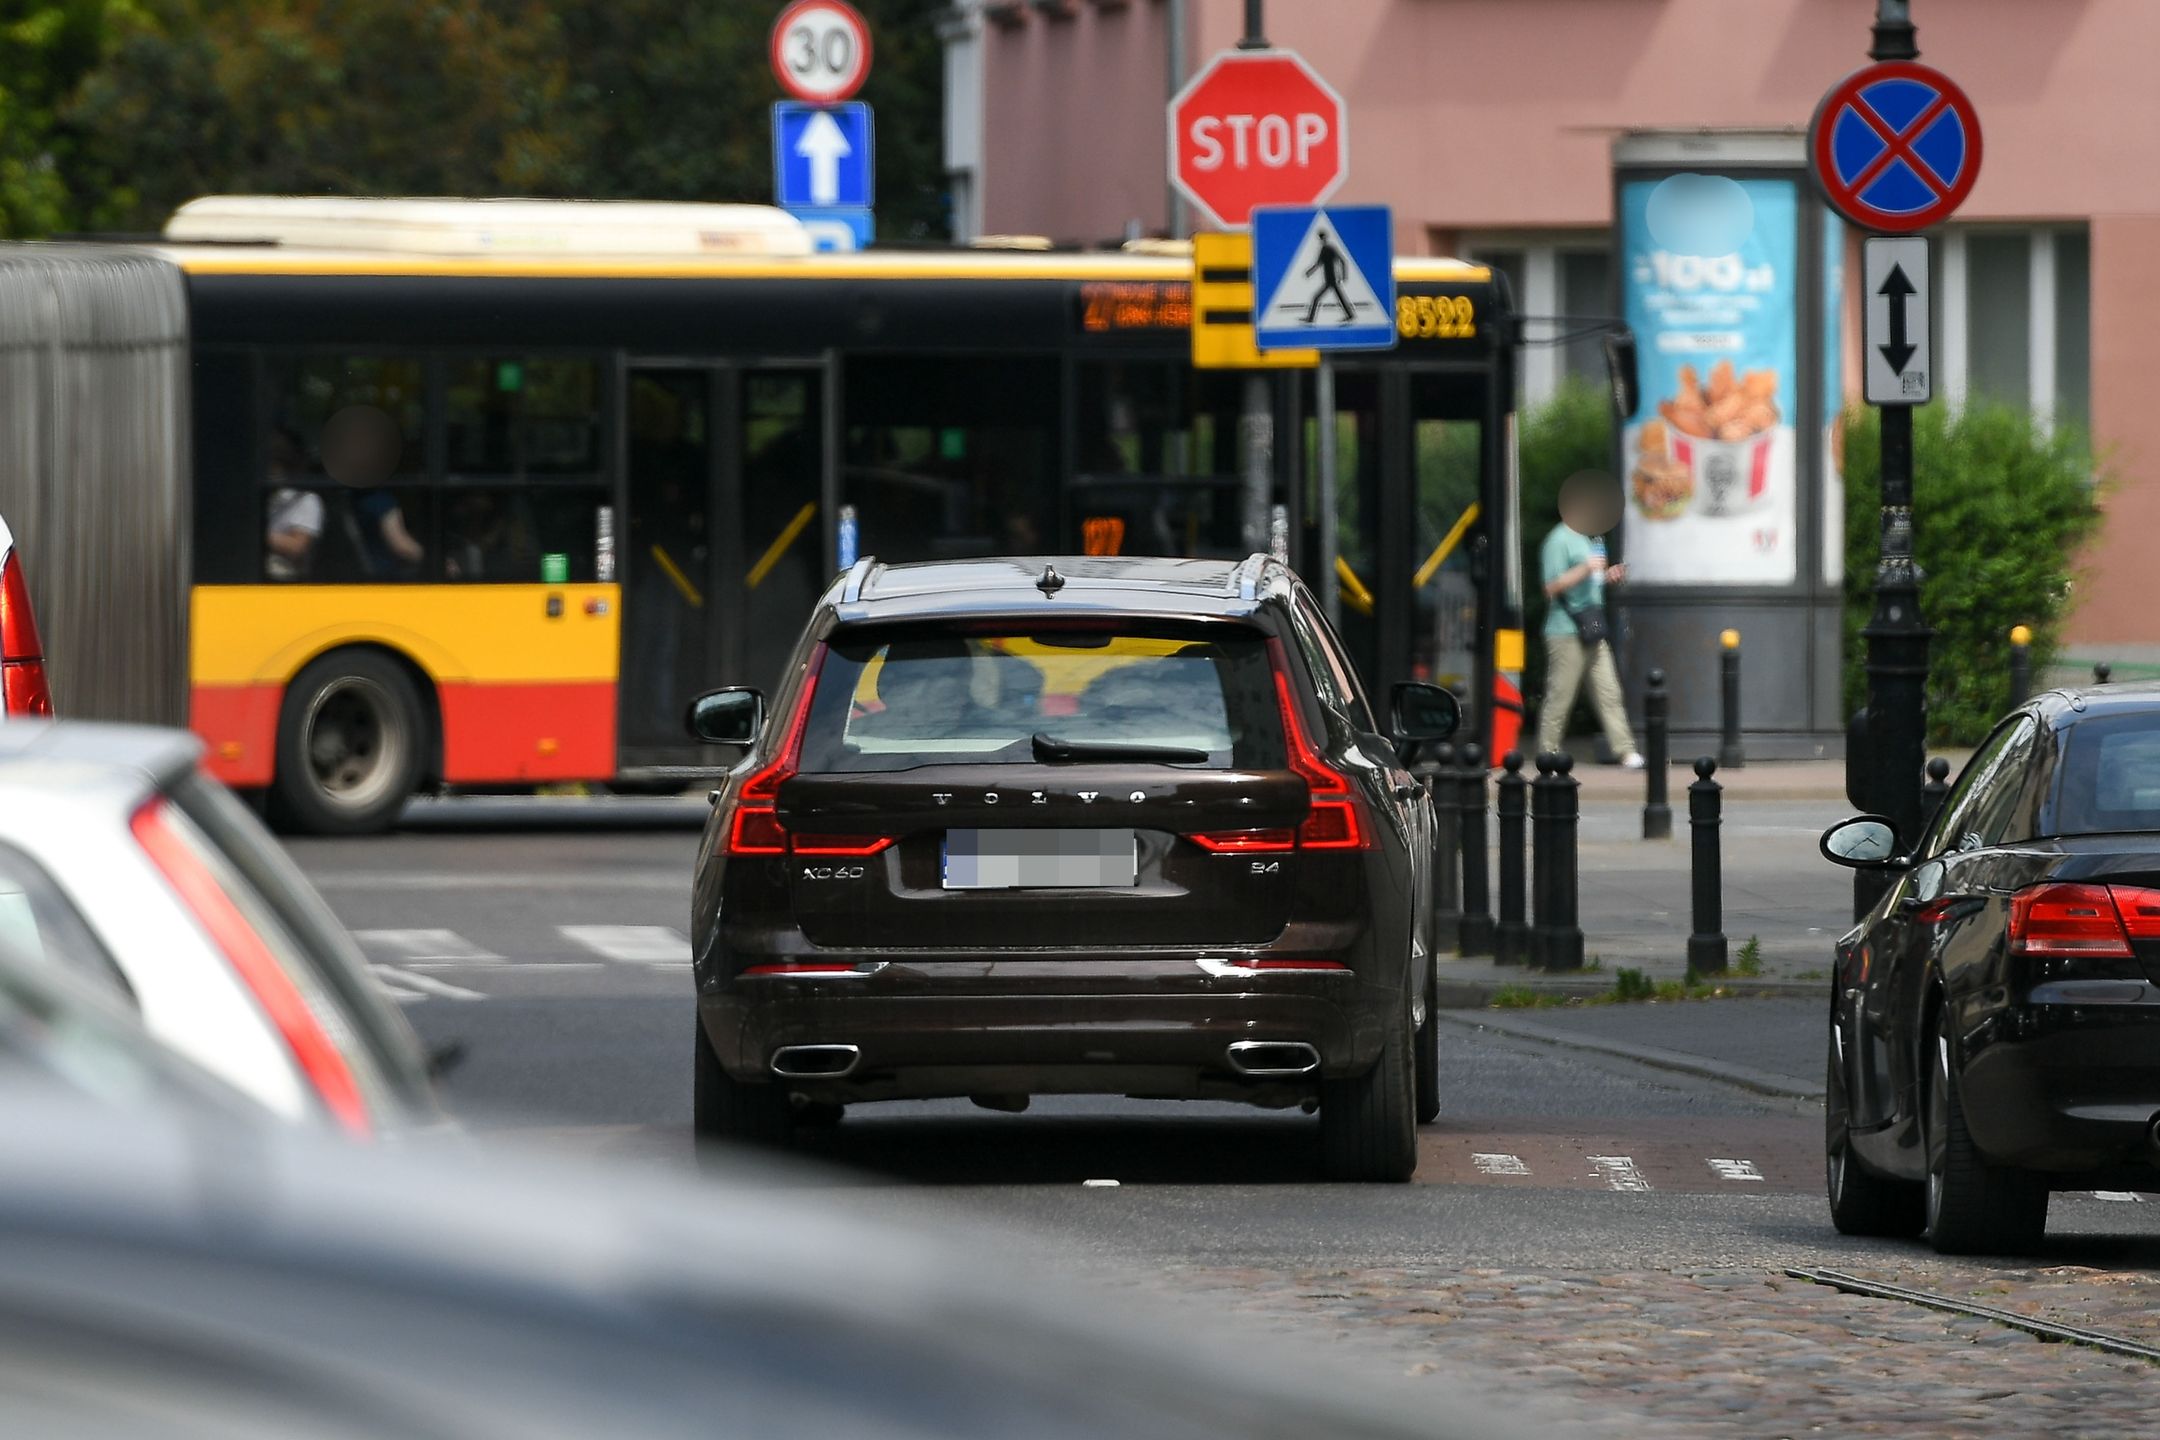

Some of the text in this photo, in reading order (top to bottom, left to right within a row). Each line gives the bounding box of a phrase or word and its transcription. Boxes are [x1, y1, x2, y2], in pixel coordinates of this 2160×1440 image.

[790, 26, 850, 73] 30
[1190, 112, 1328, 172] STOP
[932, 791, 1147, 805] VOLVO
[1251, 862, 1279, 874] B4
